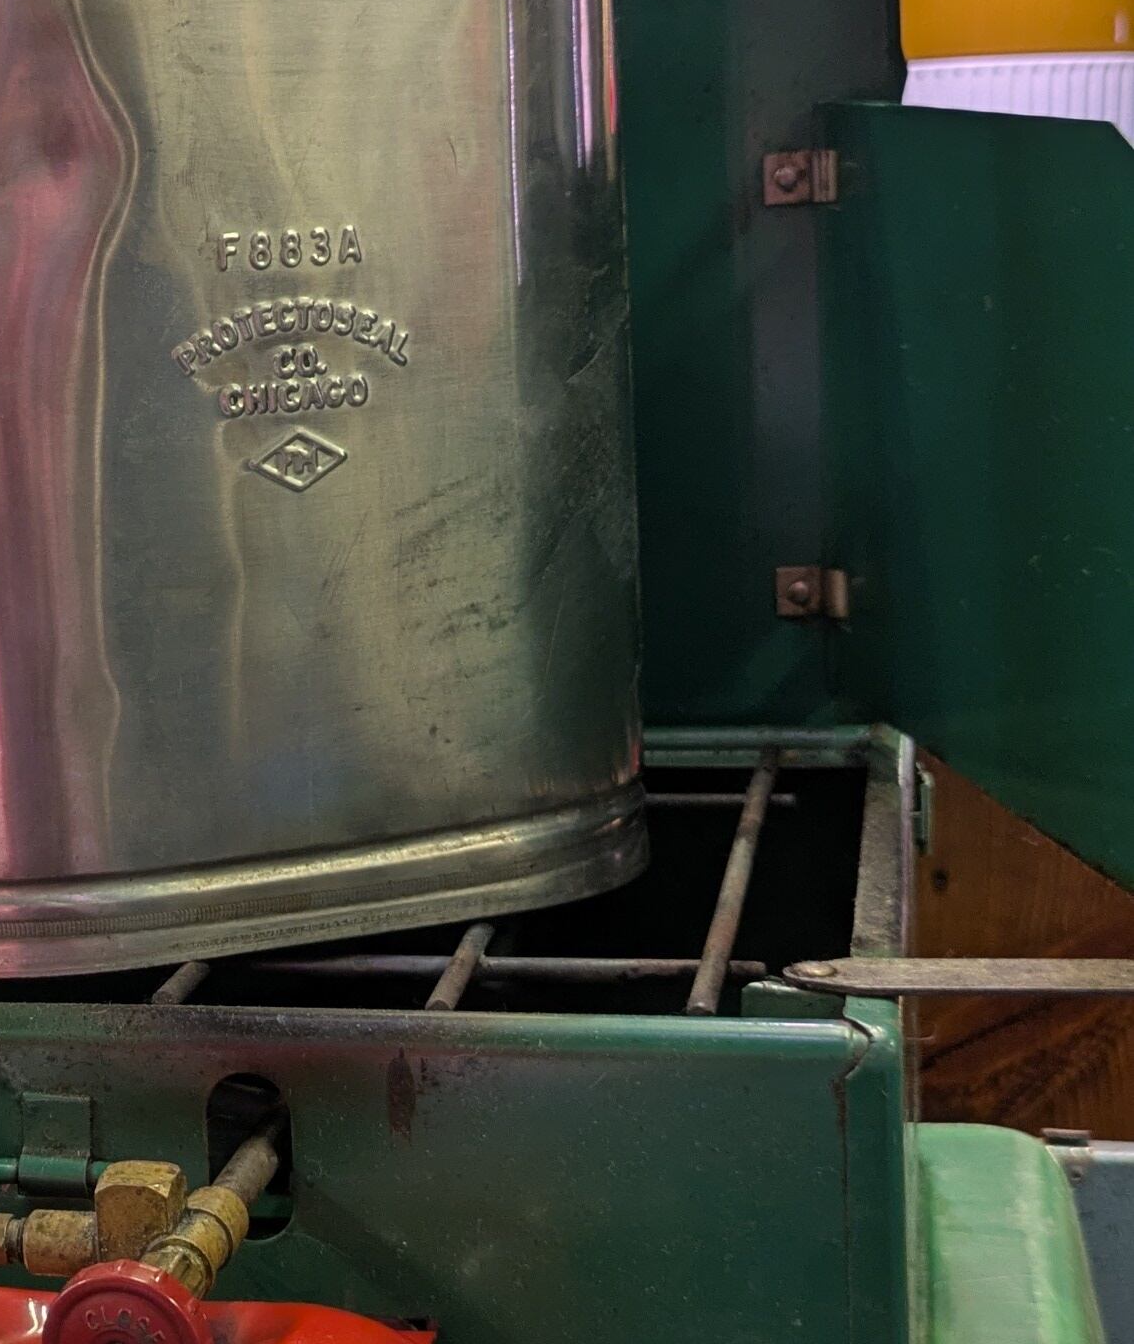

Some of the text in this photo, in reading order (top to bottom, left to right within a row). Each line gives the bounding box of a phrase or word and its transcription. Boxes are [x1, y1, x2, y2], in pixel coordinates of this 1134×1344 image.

[218, 224, 363, 272] F883A
[171, 295, 410, 377] PROTECTOSEAL
[273, 343, 328, 381] CO.
[219, 373, 369, 419] CHICAGO
